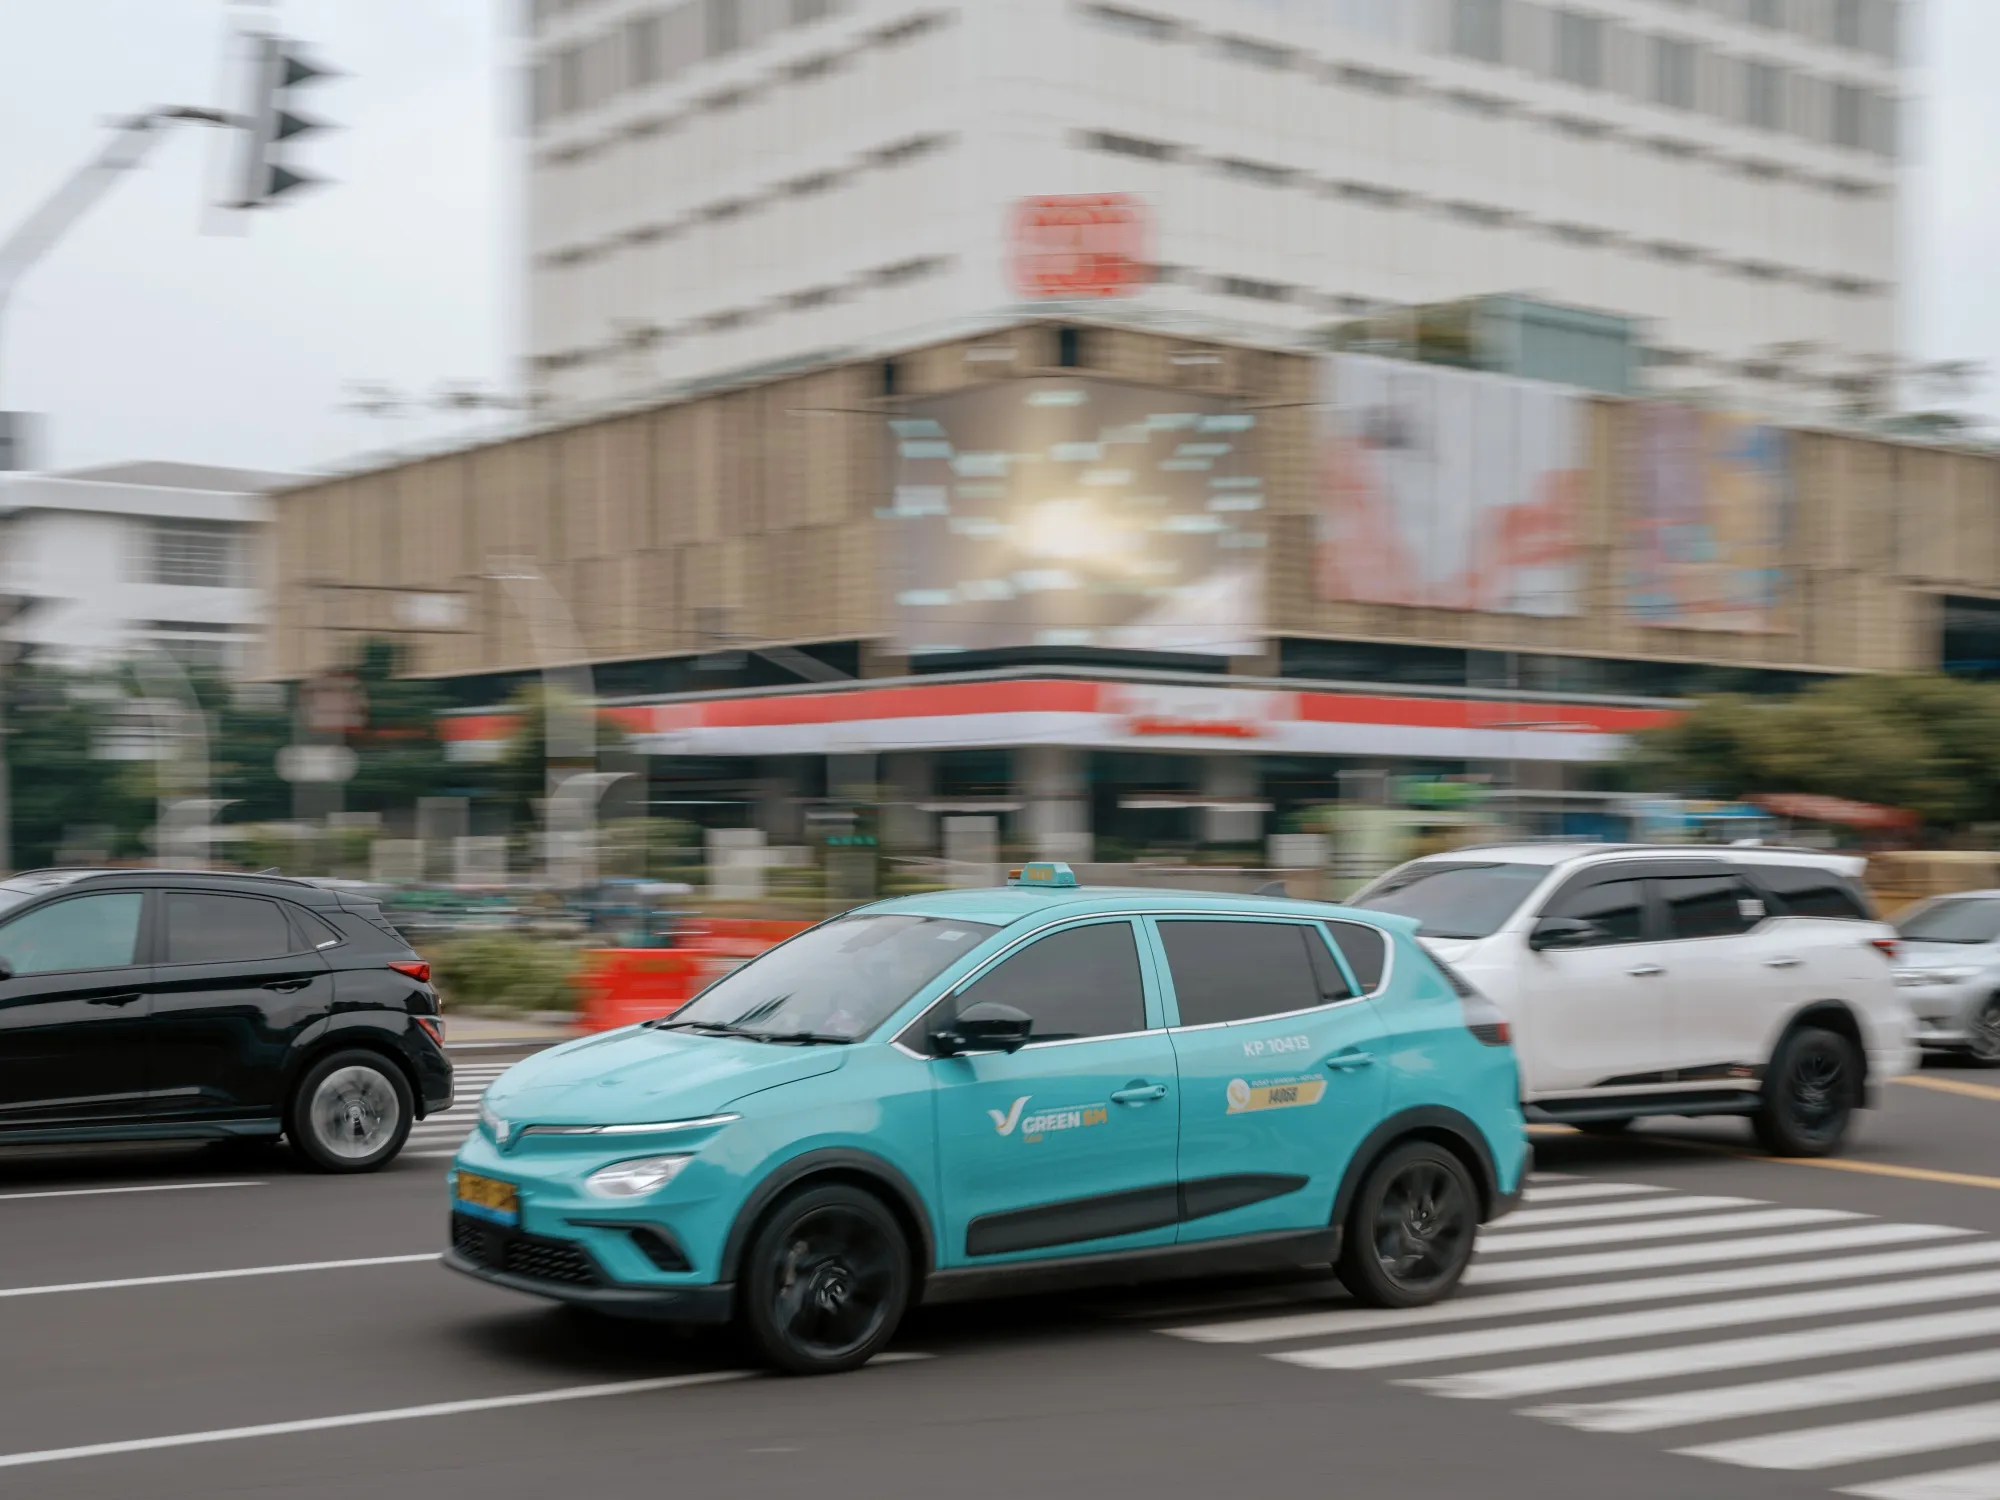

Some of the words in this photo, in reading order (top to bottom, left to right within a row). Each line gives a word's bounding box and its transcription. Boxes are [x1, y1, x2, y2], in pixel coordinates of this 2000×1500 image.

[1243, 1041, 1264, 1056] KP
[1266, 1035, 1309, 1053] 10413
[1021, 1111, 1080, 1134] GREEN
[1082, 1108, 1107, 1126] SM
